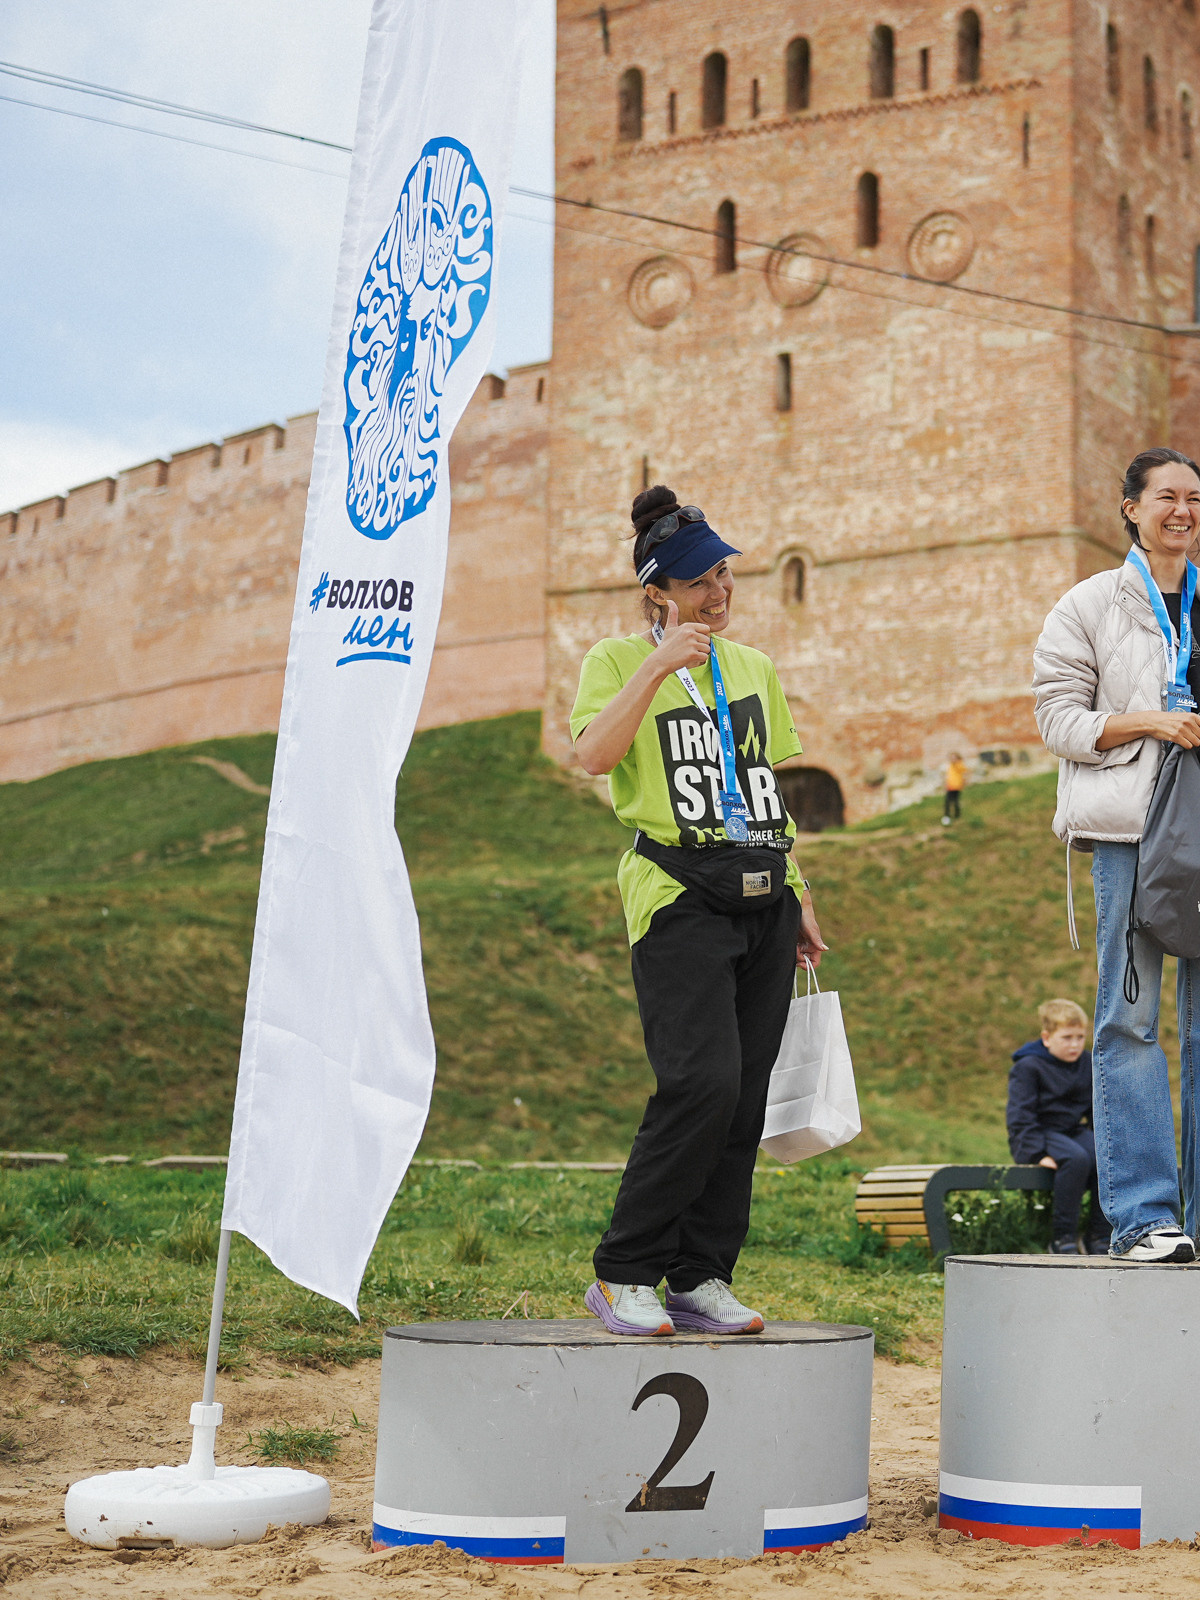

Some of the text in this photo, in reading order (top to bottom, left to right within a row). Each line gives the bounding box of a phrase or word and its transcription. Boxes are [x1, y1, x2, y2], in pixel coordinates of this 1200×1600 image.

[309, 571, 414, 614] #ВОЛХОВ
[682, 676, 695, 692] 2023
[667, 719, 719, 762] IRO
[747, 830, 774, 842] ISHER
[625, 1372, 716, 1512] 2
